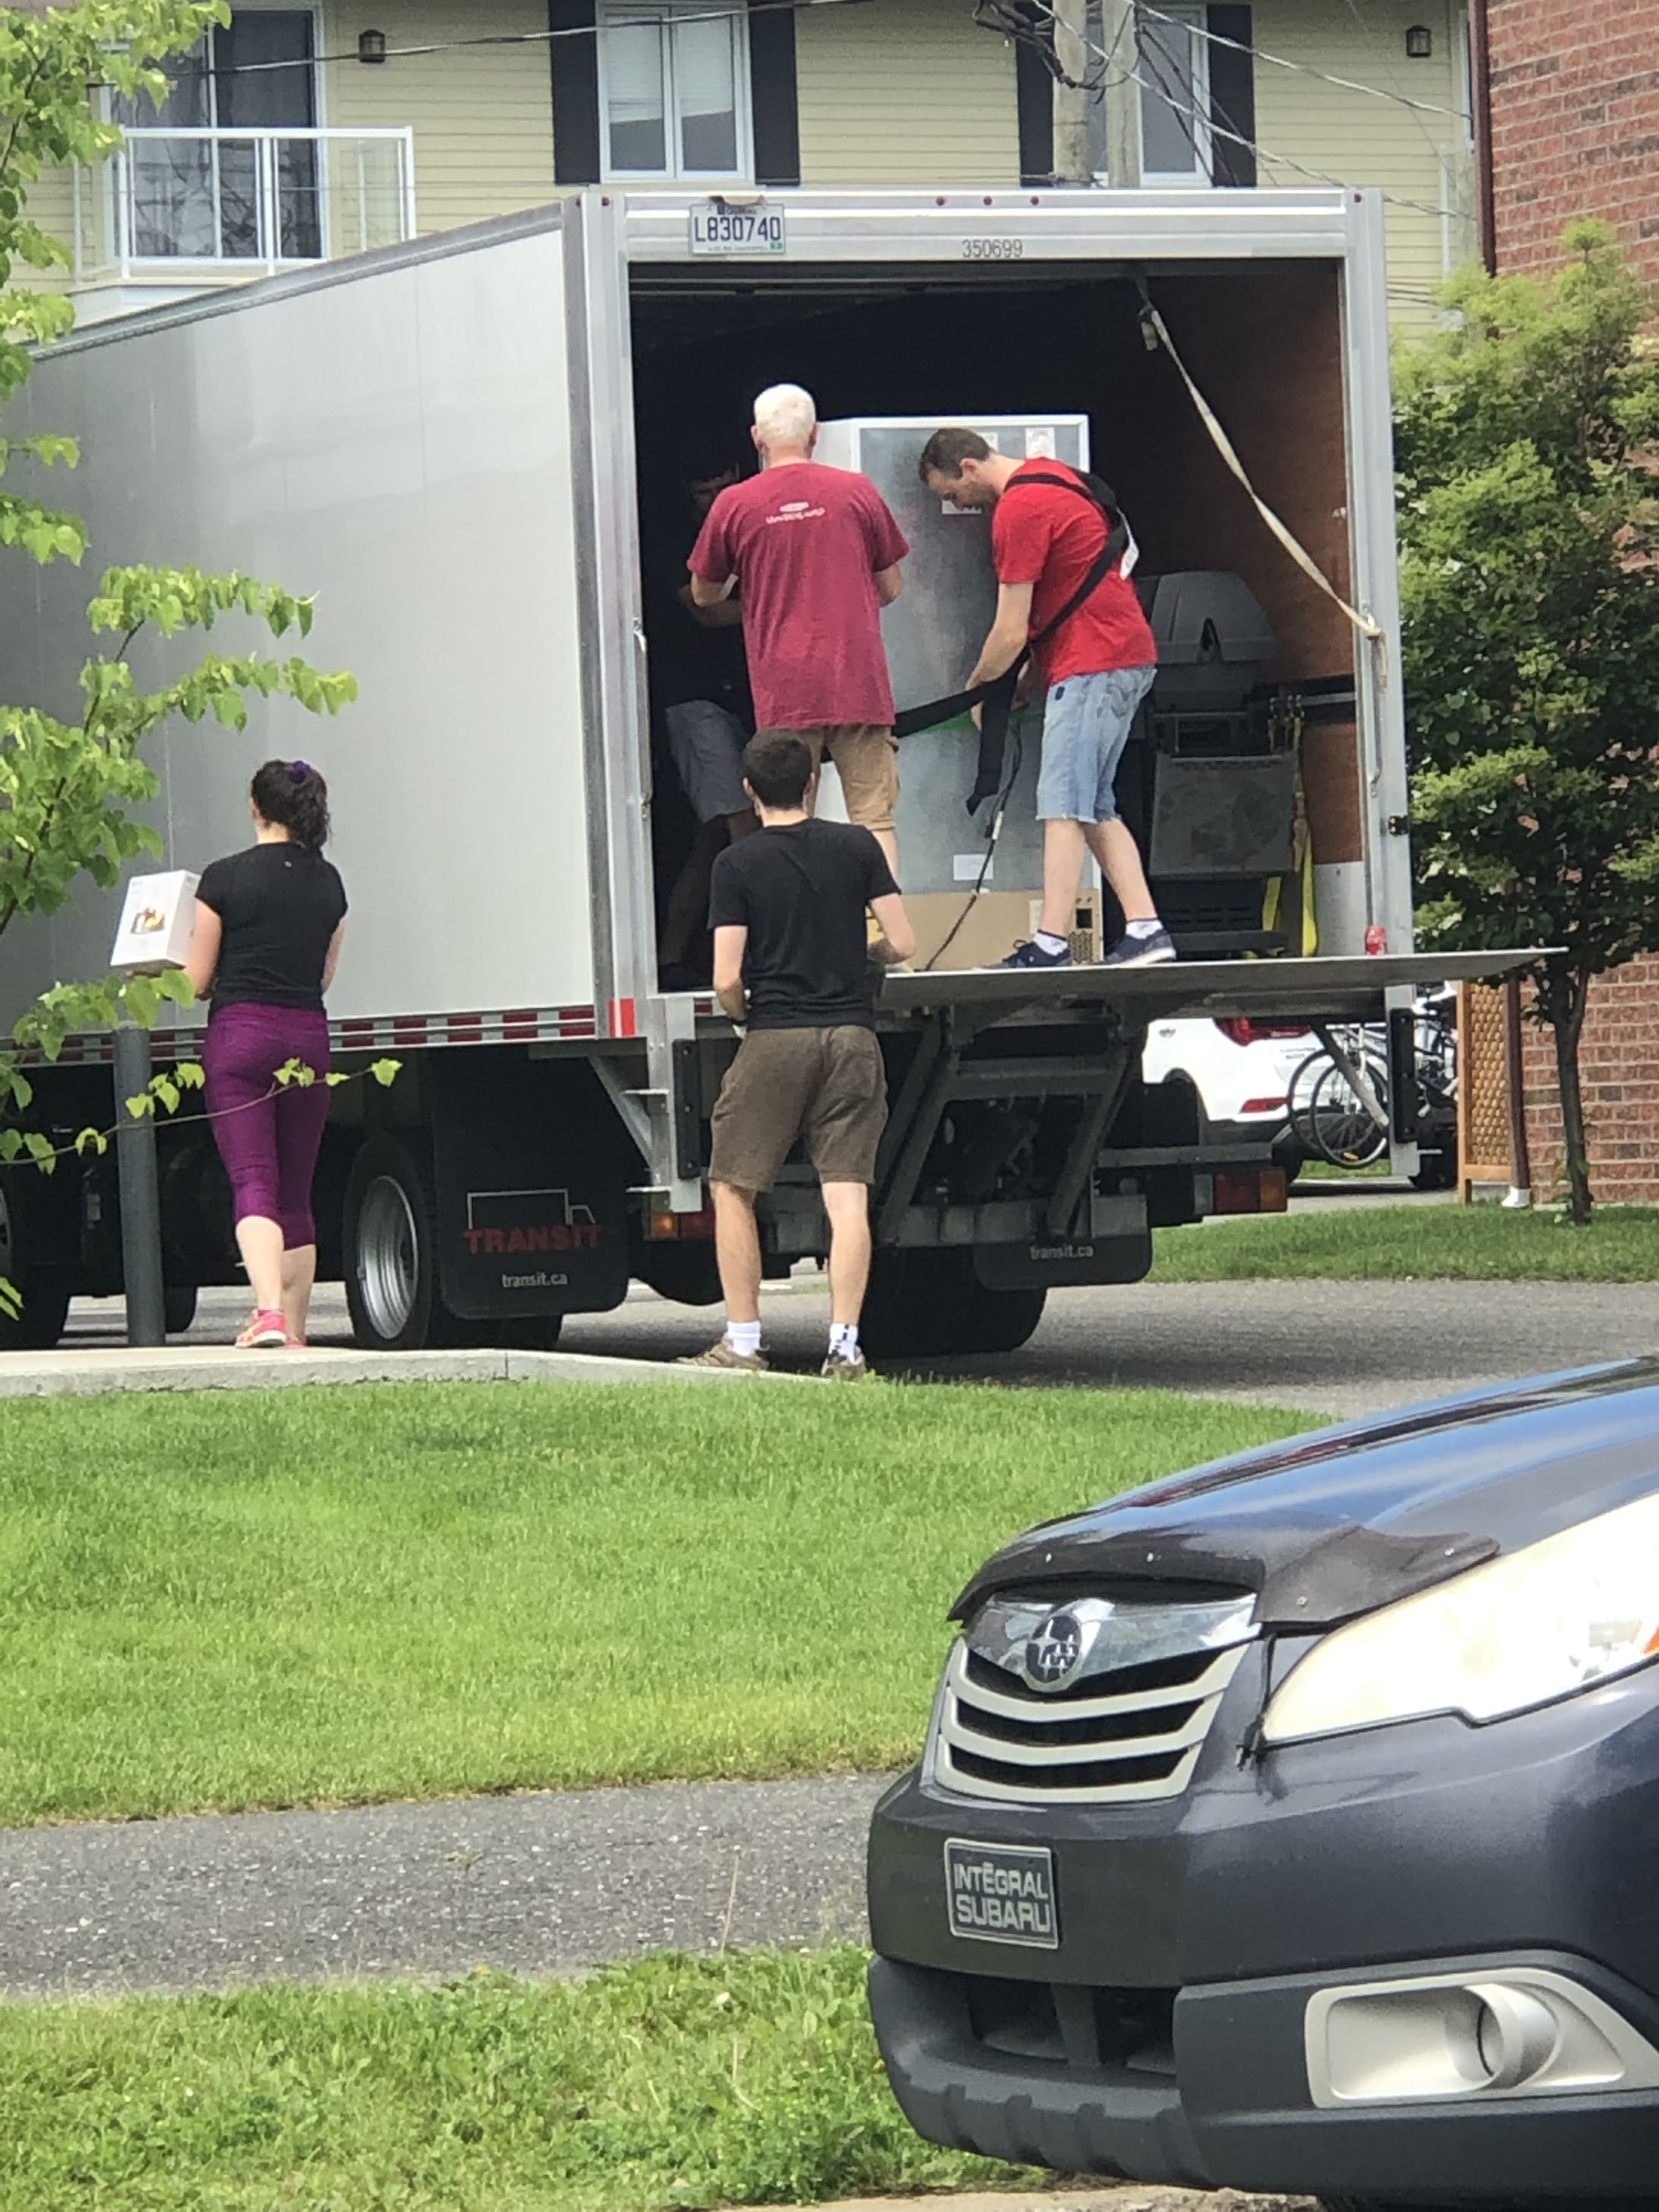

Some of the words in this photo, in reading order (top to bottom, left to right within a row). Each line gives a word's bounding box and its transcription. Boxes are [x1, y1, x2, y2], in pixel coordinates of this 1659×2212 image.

[693, 216, 781, 242] L830740
[962, 239, 1023, 257] 350699
[464, 1224, 602, 1255] TRANSIT
[501, 1272, 568, 1288] transit.ca
[956, 1894, 1051, 1933] SUBARU
